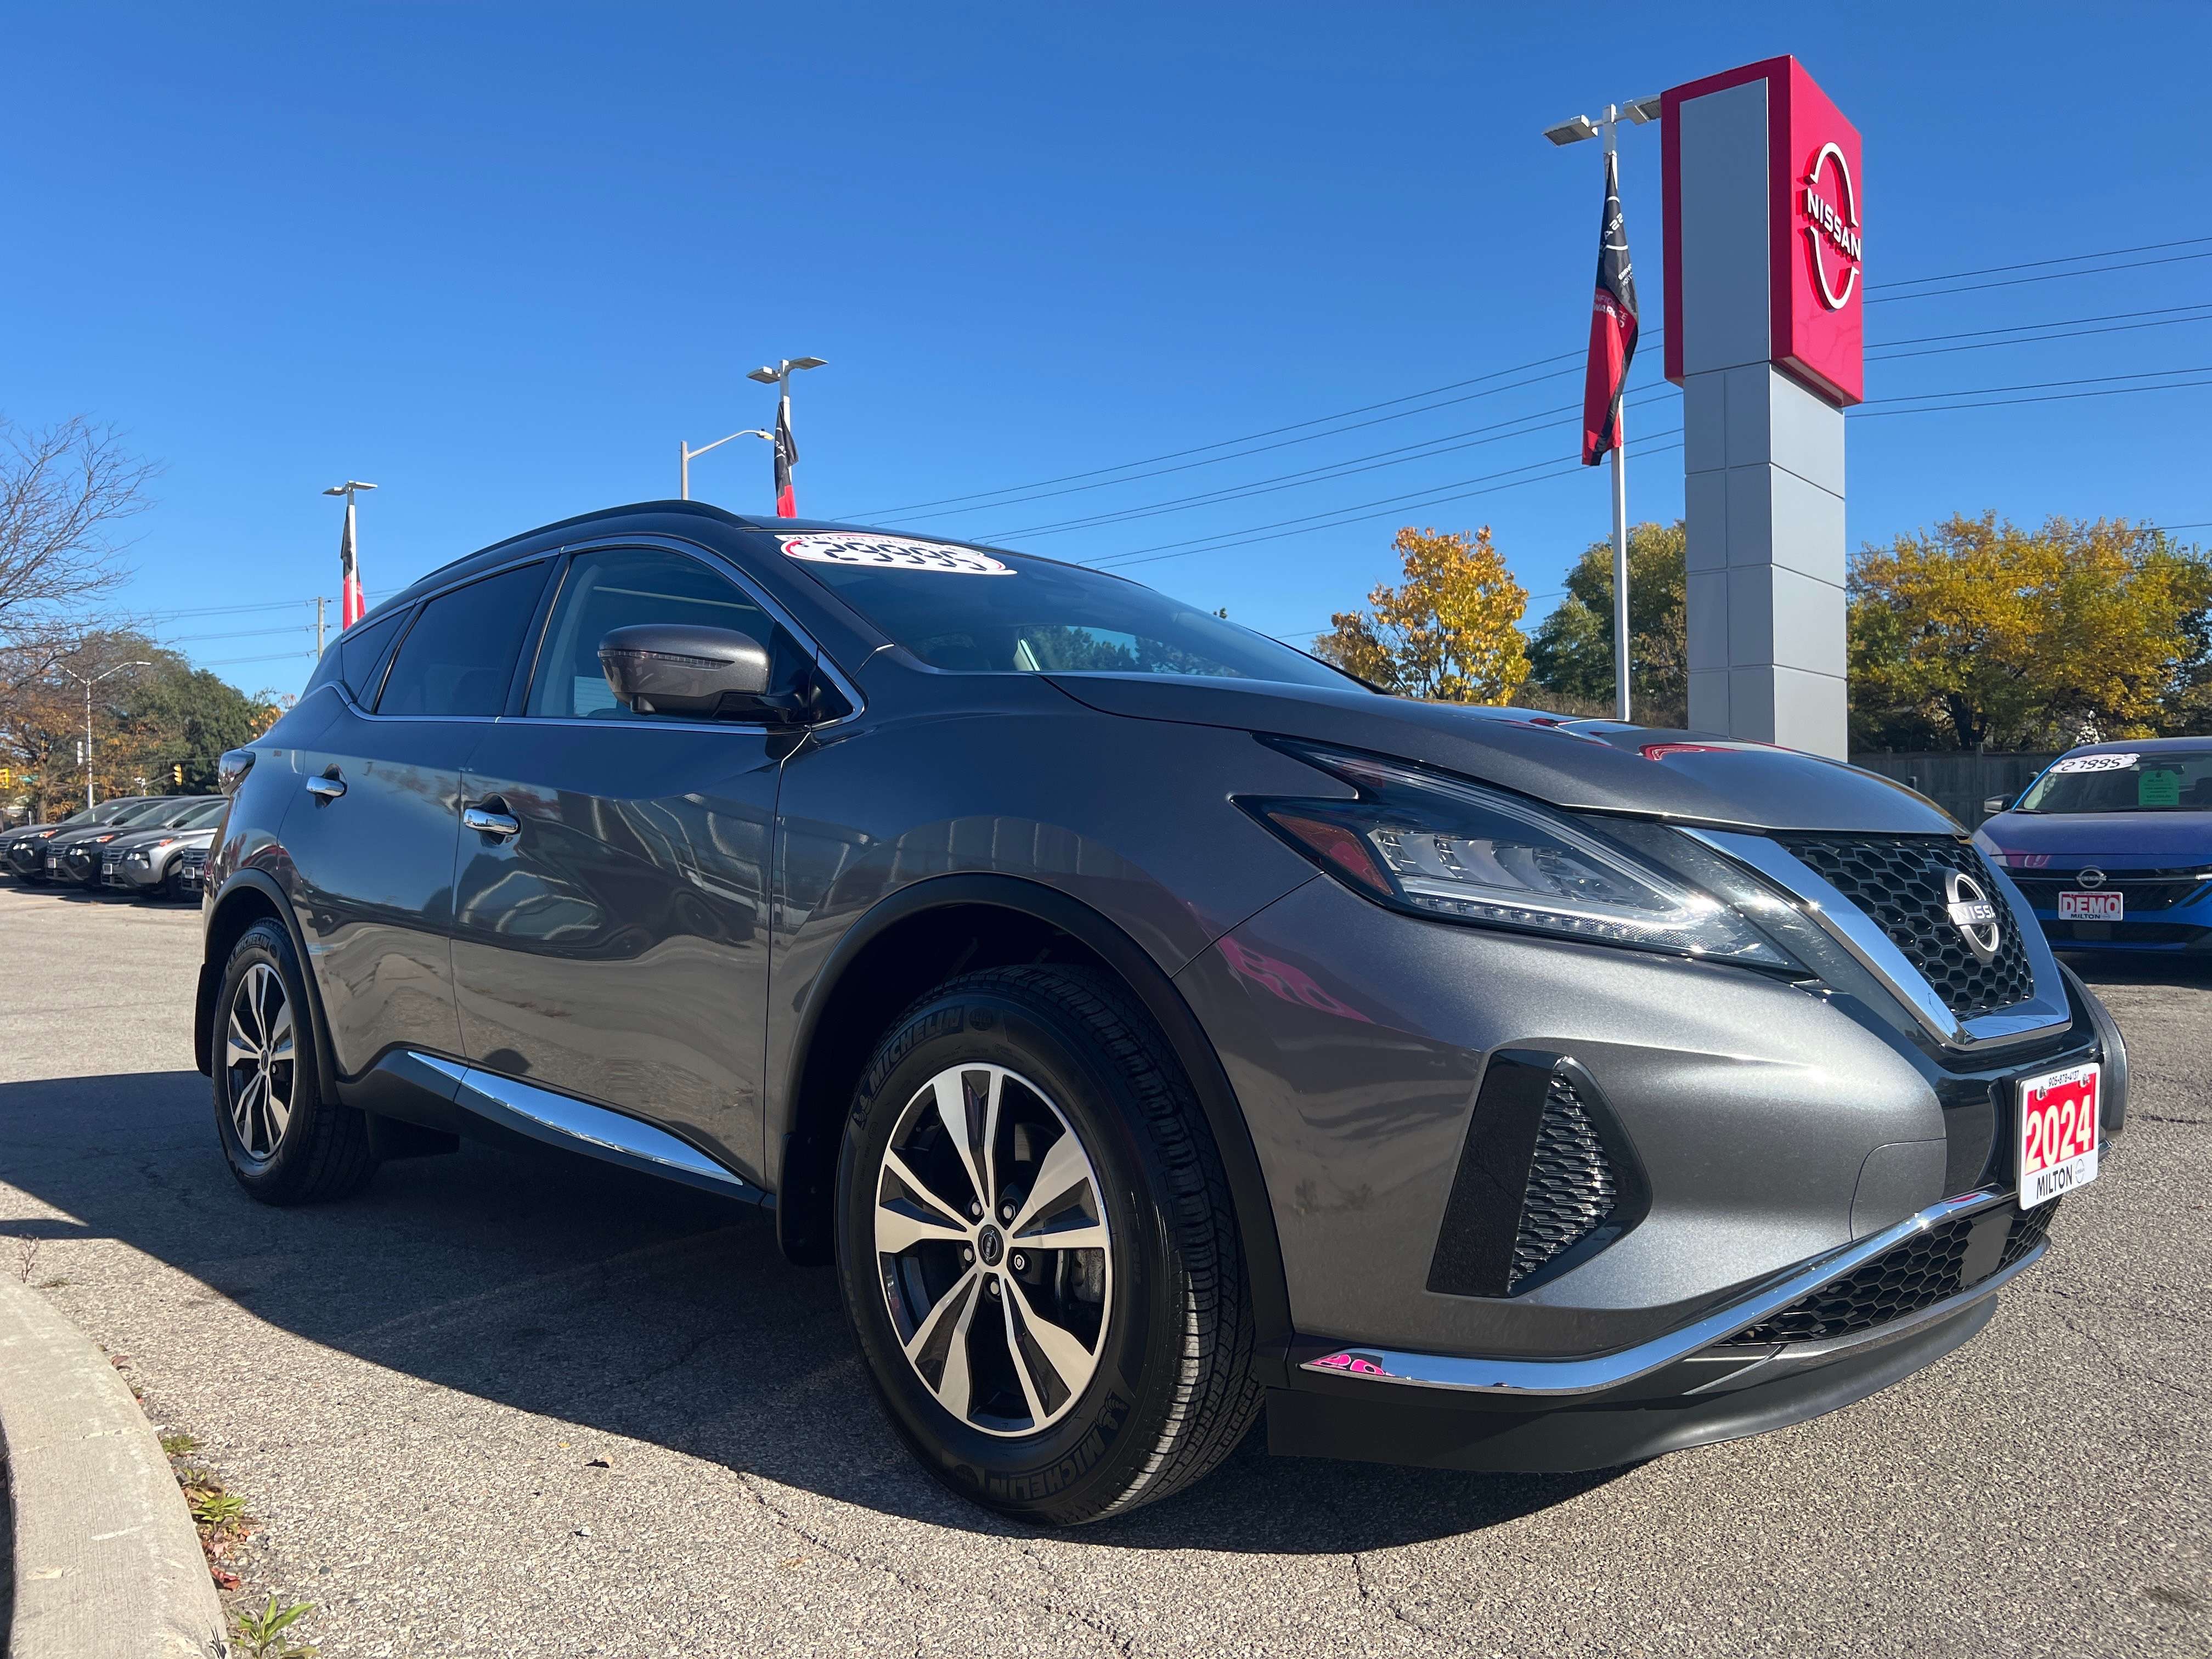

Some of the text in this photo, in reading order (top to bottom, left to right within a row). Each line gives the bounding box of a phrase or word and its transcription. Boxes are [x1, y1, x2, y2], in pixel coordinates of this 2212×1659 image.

[1807, 187, 1861, 262] NISSAN
[812, 541, 988, 571] 29995
[2061, 758, 2122, 771] 27995
[1954, 905, 1996, 920] NISSA
[2062, 896, 2119, 914] DEMO
[868, 1007, 961, 1096] MICHELIN
[2025, 1094, 2091, 1172] 2024
[2036, 1164, 2073, 1200] MILTON
[989, 1427, 1107, 1500] MICHELIN
